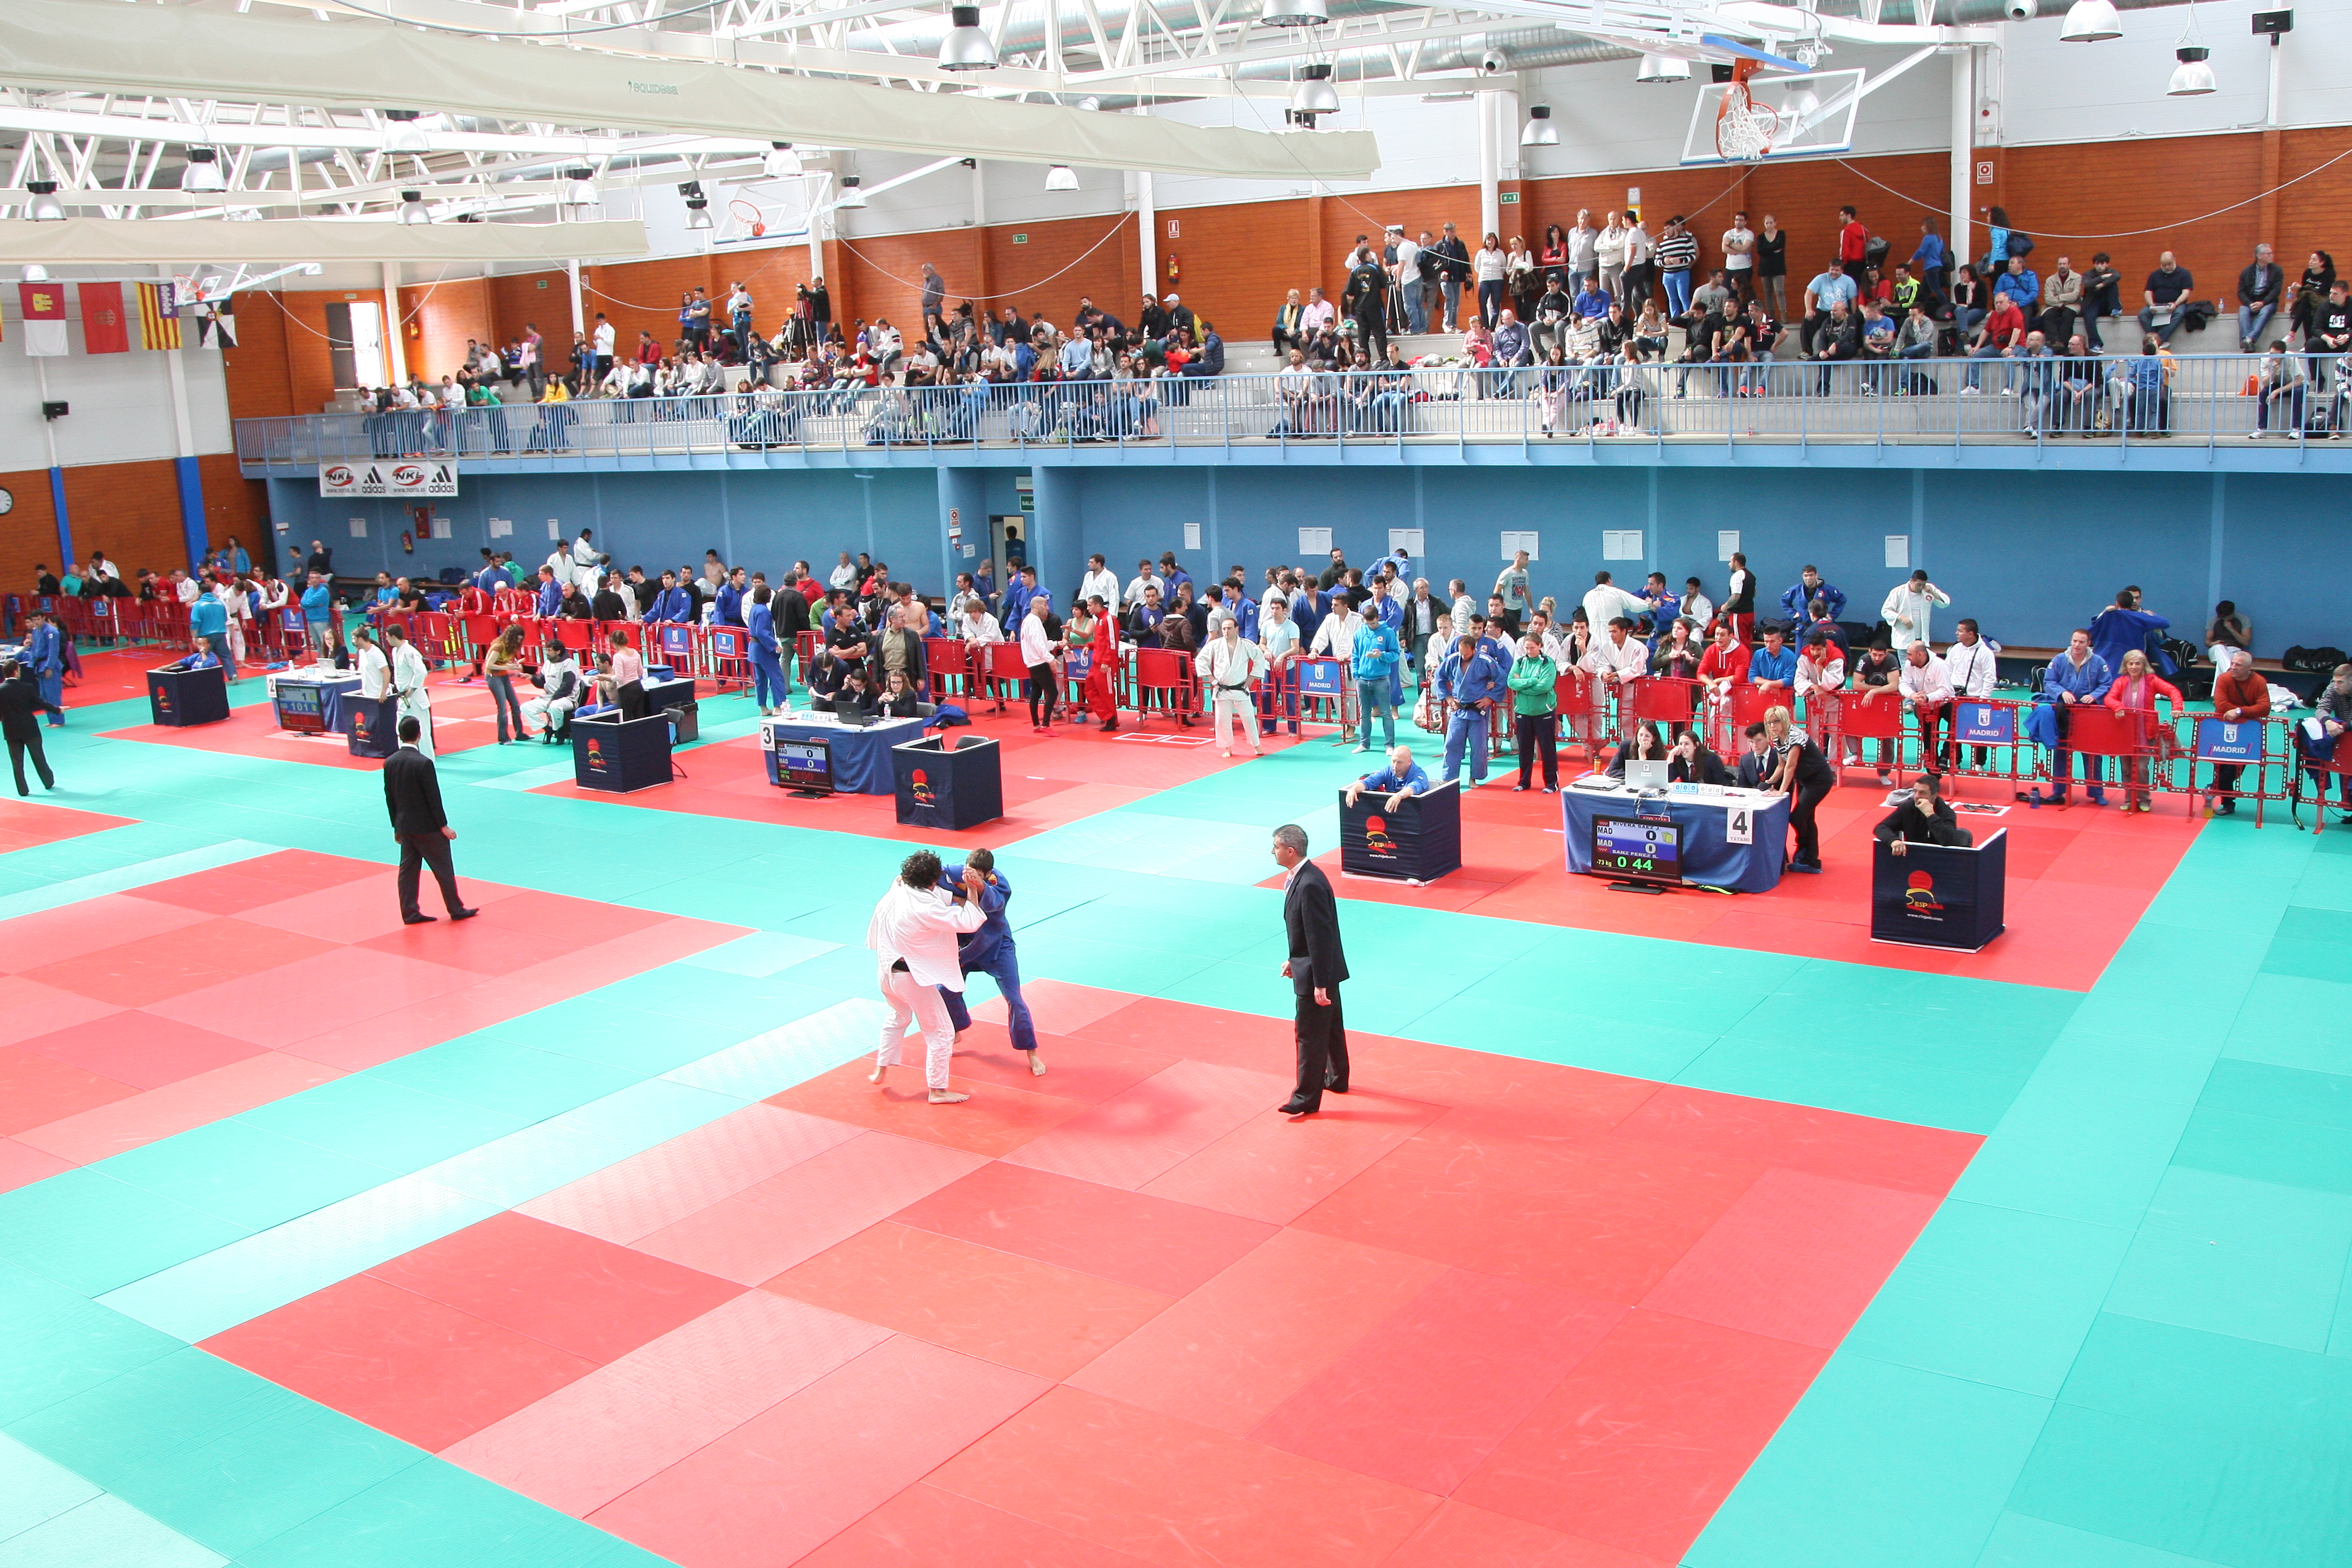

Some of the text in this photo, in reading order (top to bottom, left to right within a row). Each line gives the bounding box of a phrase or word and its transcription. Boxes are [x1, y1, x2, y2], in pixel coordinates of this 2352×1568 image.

[428, 485, 455, 493] adidas
[269, 679, 275, 692] 2
[291, 702, 309, 711] 101
[763, 727, 772, 744] 3
[1733, 811, 1748, 835] 4
[1646, 831, 1656, 840] 0
[1645, 843, 1657, 854] 0
[1617, 857, 1653, 871] 0 44
